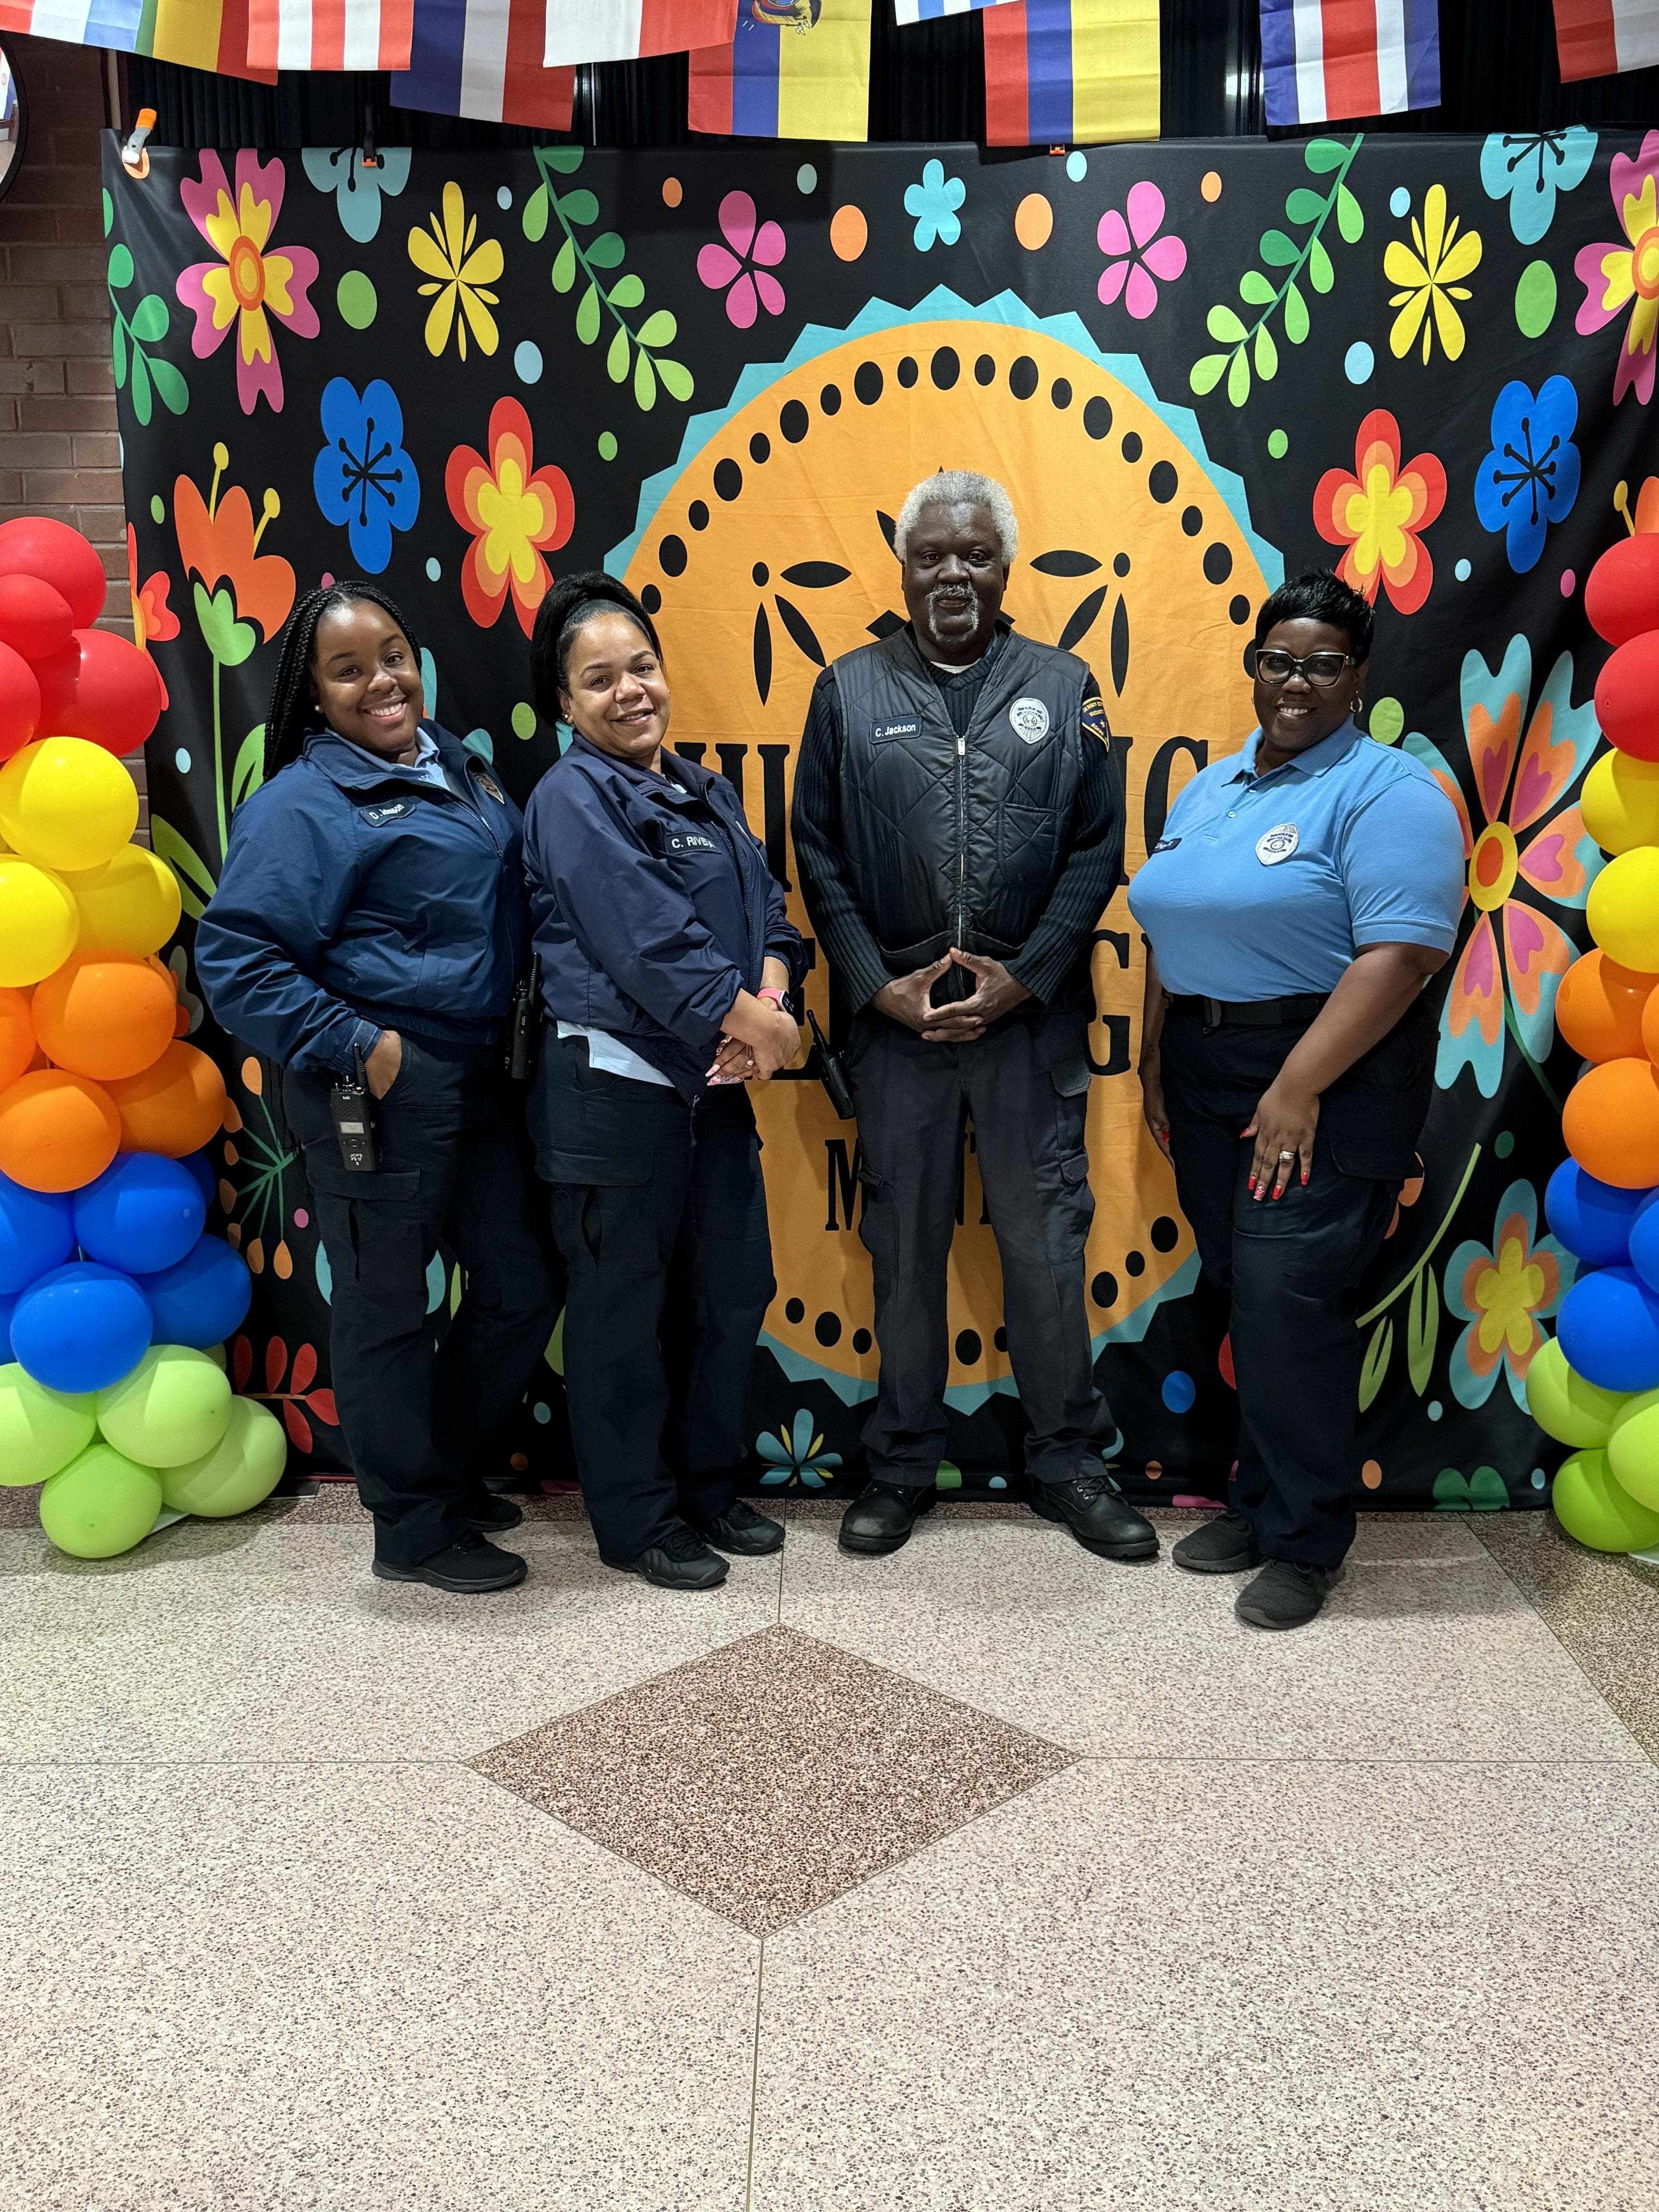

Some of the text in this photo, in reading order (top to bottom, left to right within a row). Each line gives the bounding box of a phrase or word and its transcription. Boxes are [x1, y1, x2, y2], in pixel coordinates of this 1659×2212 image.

[875, 724, 917, 738] C. Jackson
[671, 838, 684, 849] C.
